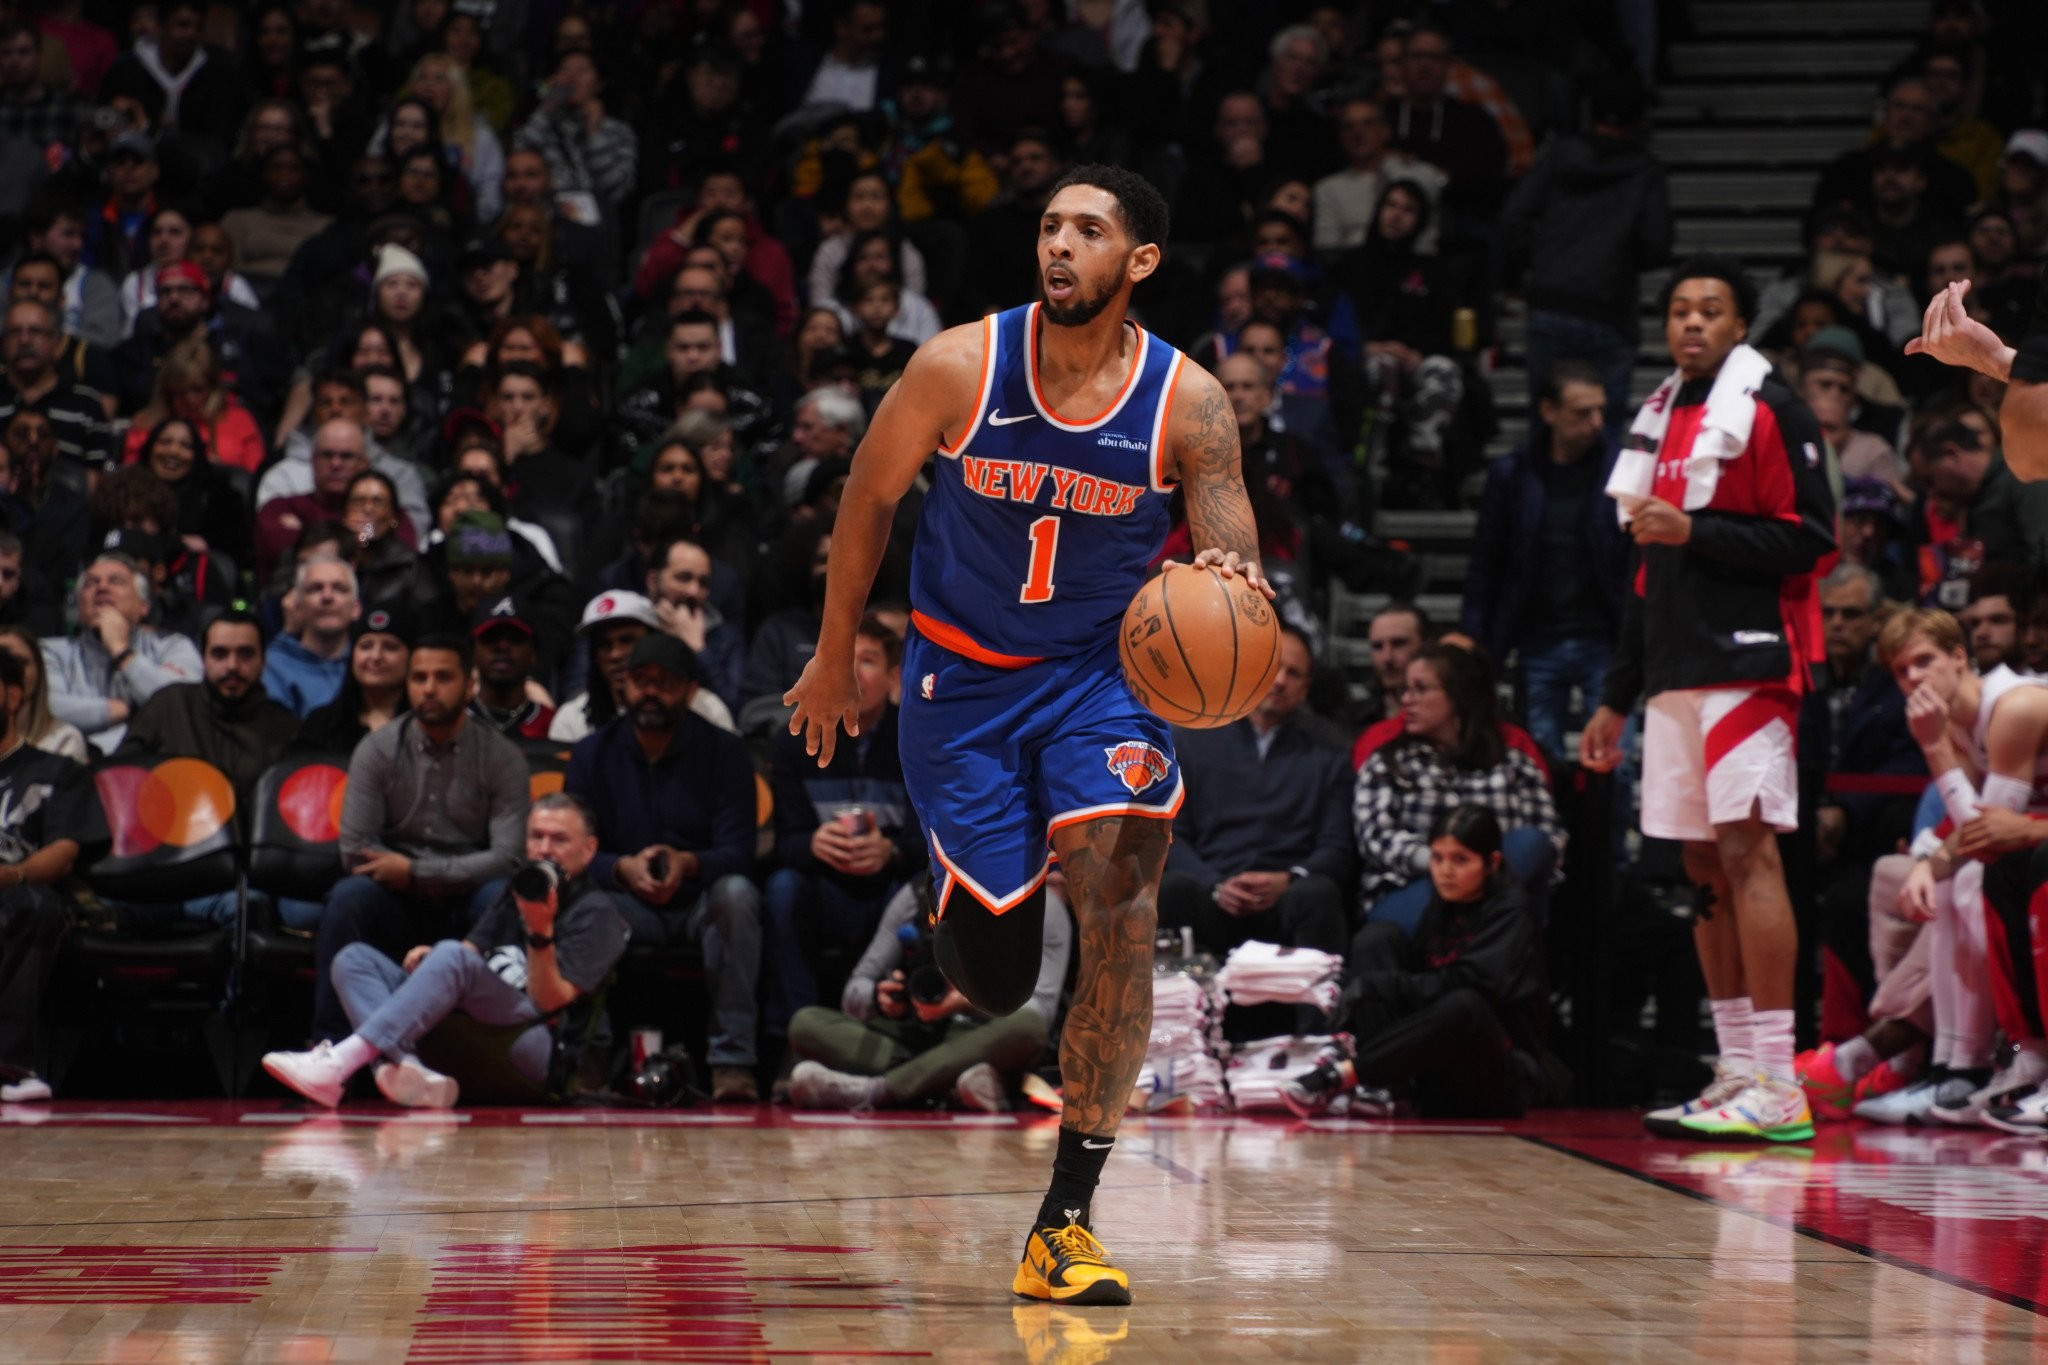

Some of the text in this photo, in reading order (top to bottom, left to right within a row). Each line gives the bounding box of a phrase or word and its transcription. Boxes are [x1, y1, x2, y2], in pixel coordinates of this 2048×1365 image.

[1097, 437, 1149, 451] abu dhabi
[963, 455, 1147, 516] NEW YORK
[1020, 515, 1060, 603] 1
[1109, 745, 1166, 776] KNICKS
